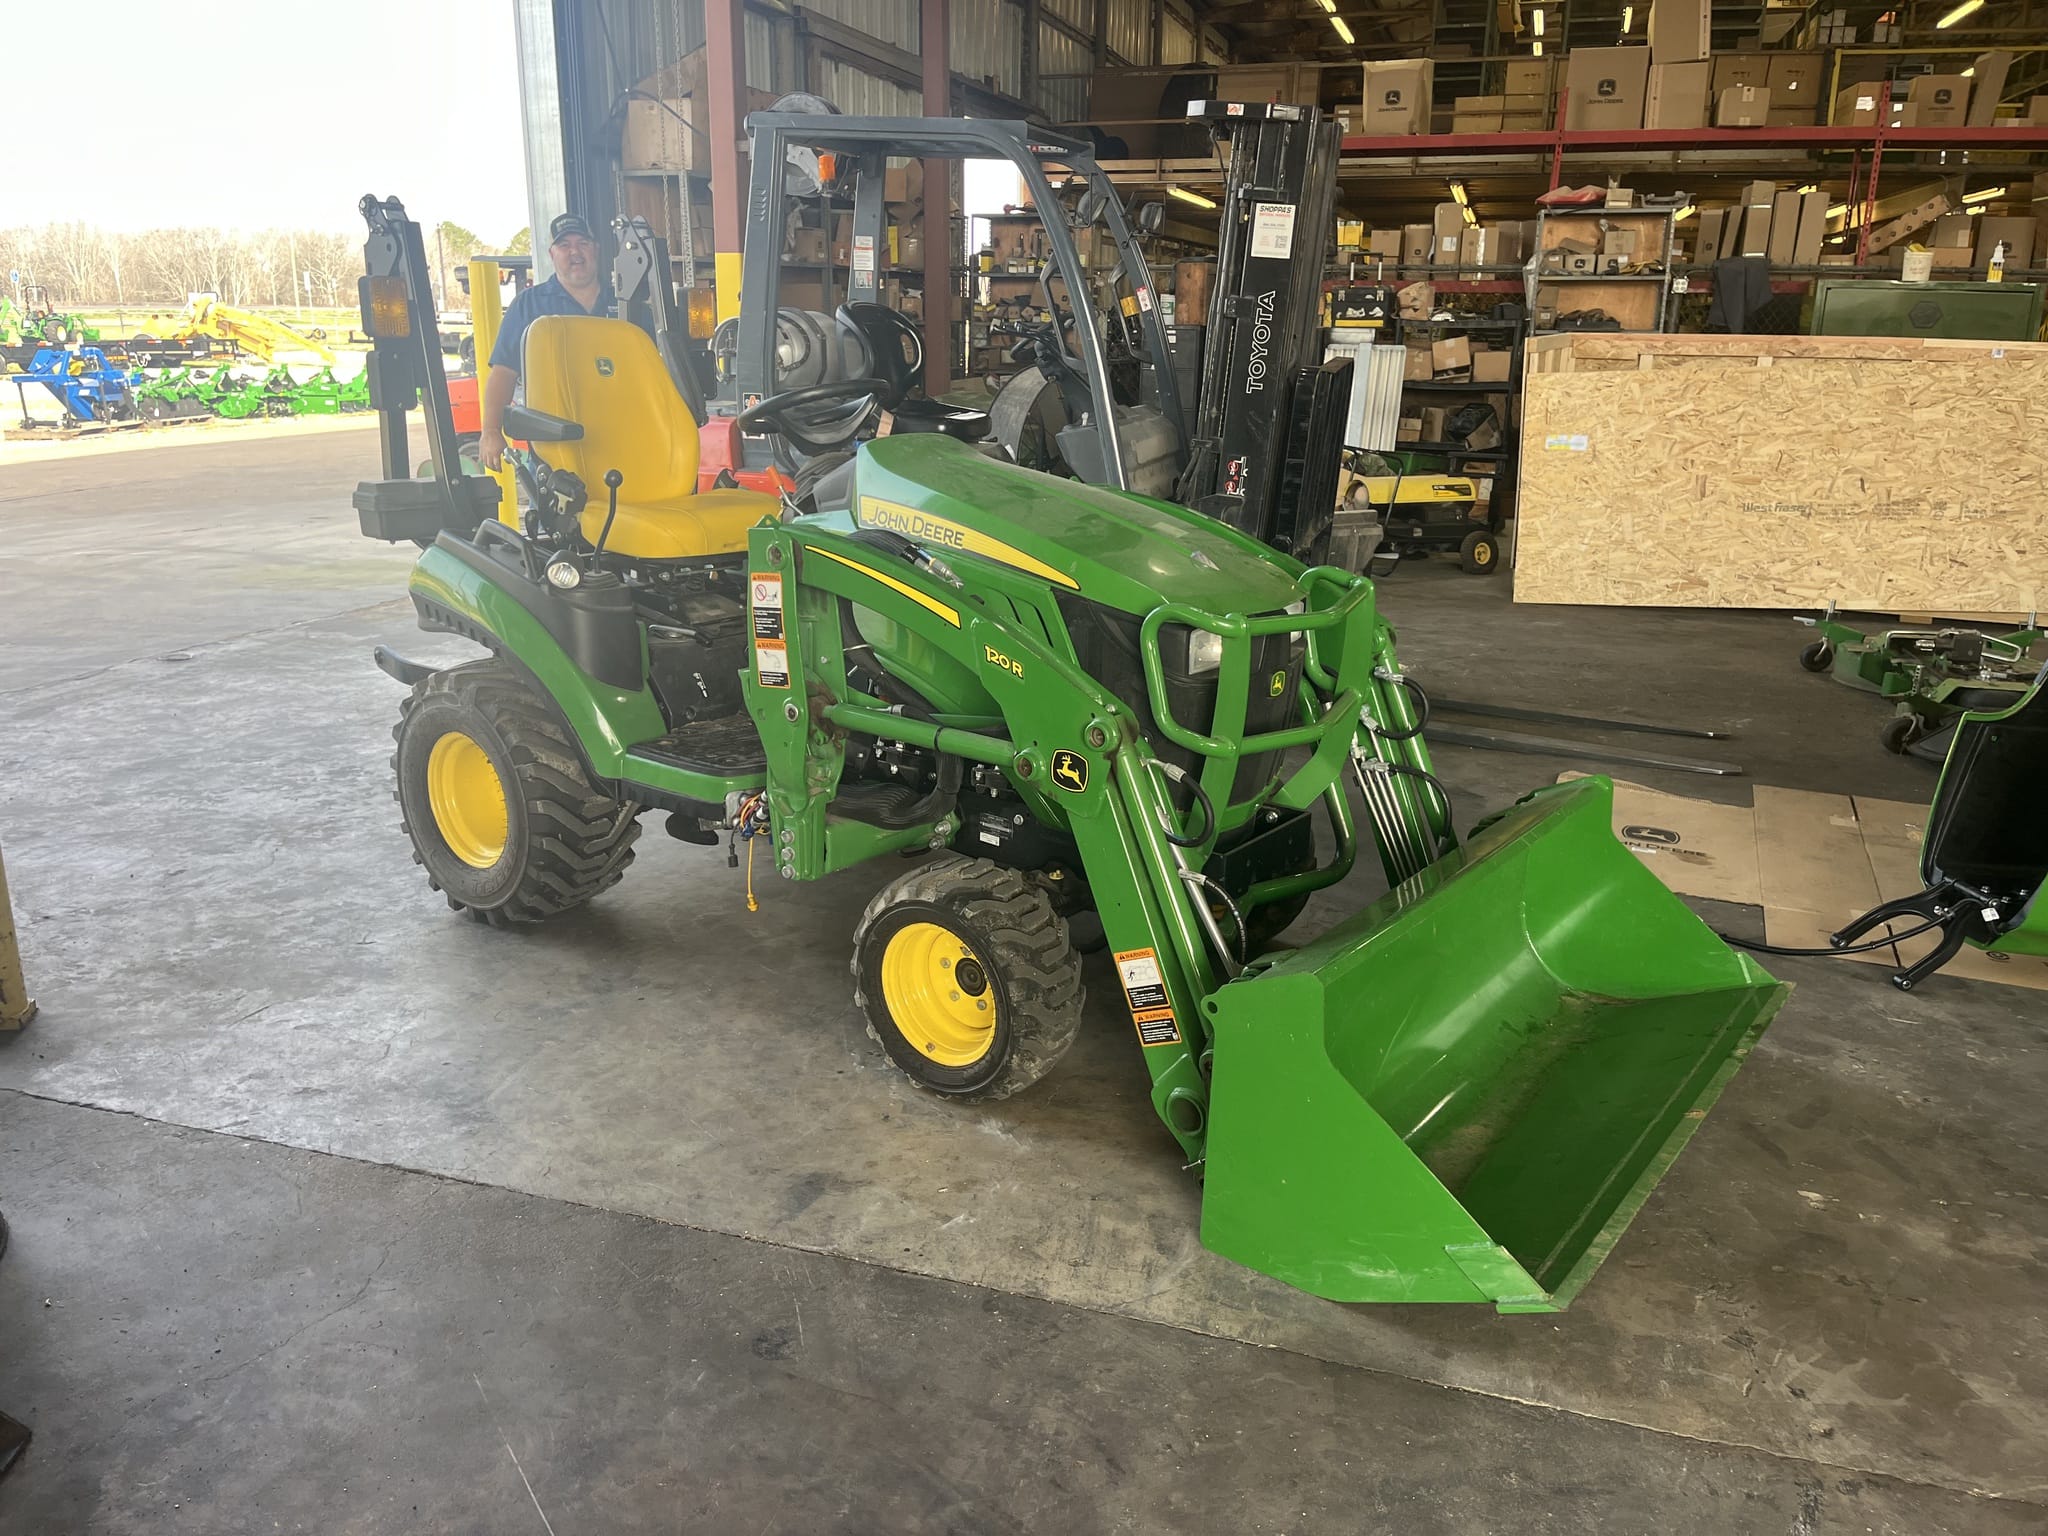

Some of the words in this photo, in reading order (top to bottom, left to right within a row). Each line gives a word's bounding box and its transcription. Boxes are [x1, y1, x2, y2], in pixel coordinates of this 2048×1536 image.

[1246, 290, 1276, 394] TOYOTA
[869, 505, 910, 531] JOHN
[911, 515, 965, 547] DEERE
[1125, 950, 1150, 959] WARNING
[1145, 1011, 1170, 1020] WARNING
